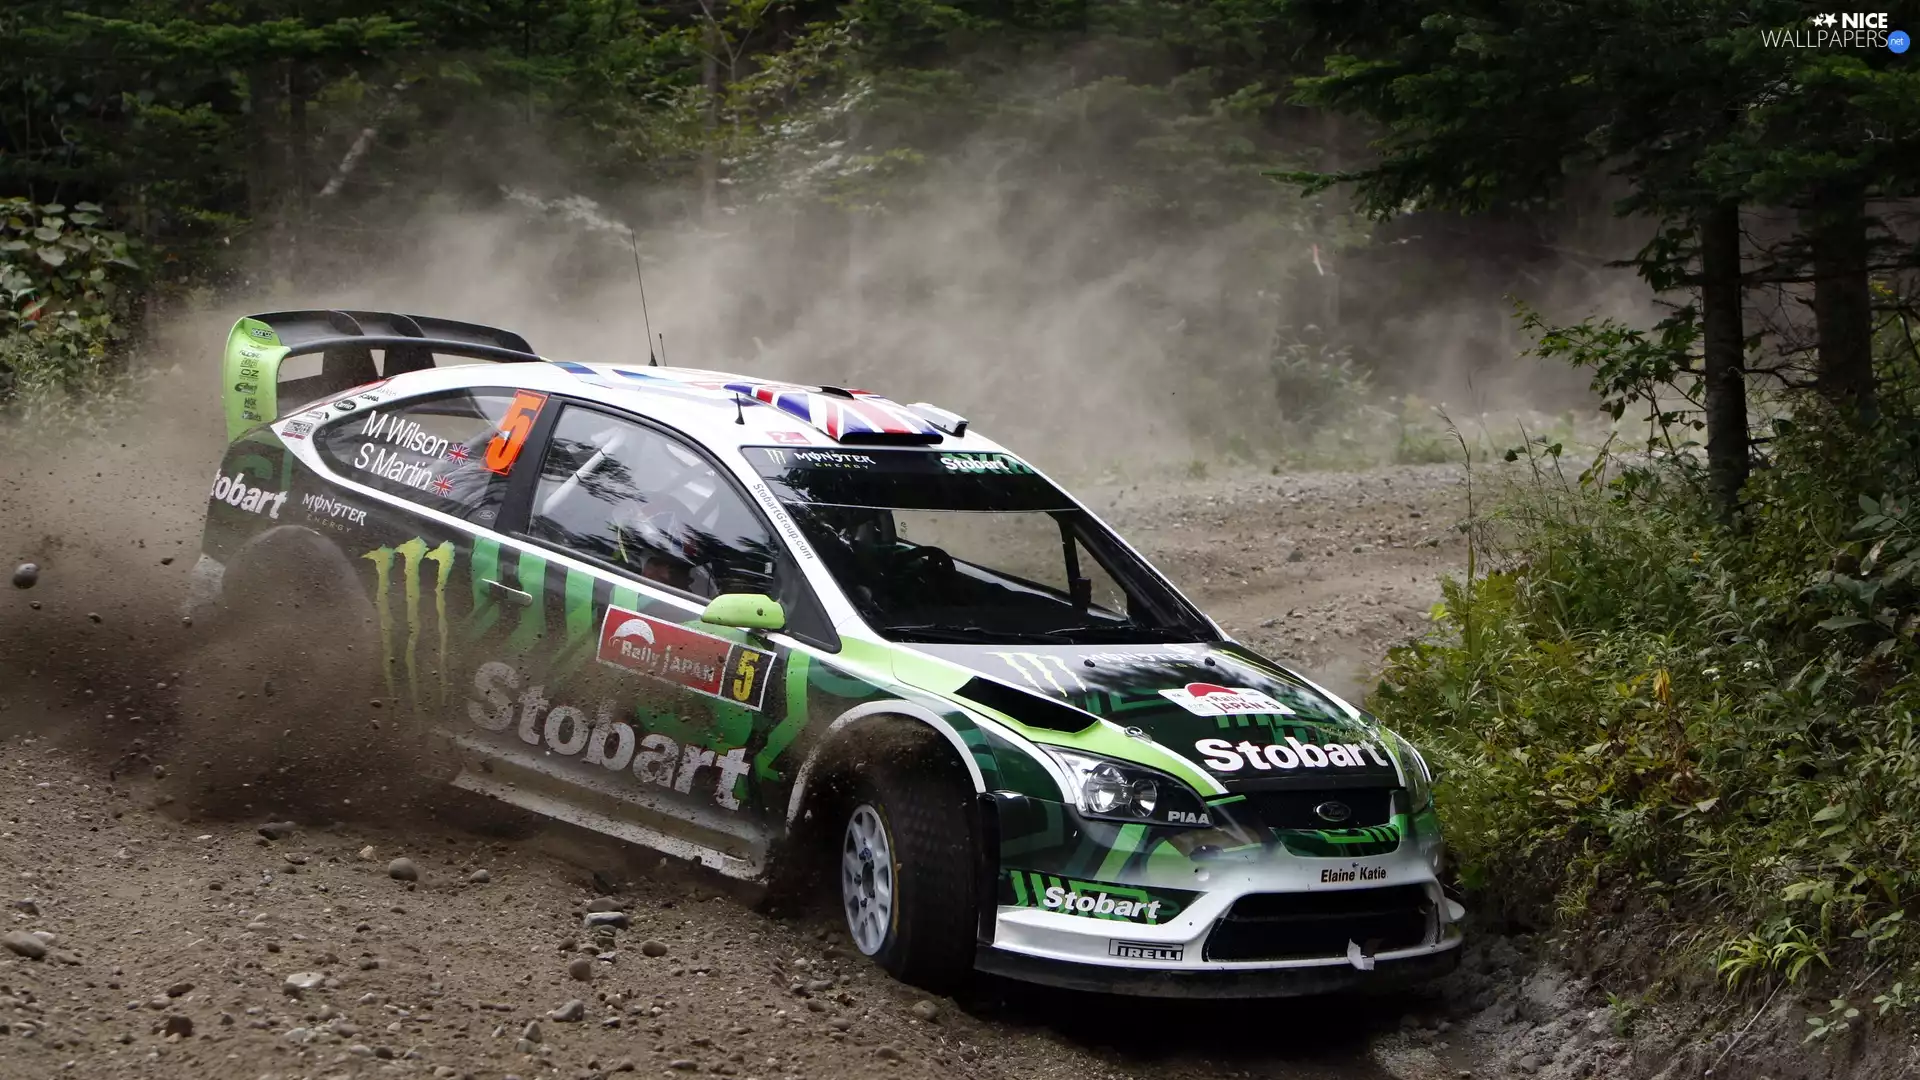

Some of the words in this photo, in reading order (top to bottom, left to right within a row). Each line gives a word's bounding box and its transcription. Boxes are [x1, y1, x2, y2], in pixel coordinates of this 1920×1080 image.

[361, 410, 388, 438] M
[386, 416, 448, 459] Wilson
[485, 392, 544, 470] 5
[354, 443, 374, 470] S
[375, 448, 432, 490] Martin
[815, 462, 869, 470] ENERGY
[941, 457, 1010, 471] Stobart
[307, 515, 351, 532] ENERGY
[753, 484, 814, 560] StobartGroup.com
[621, 640, 661, 667] Rally
[733, 650, 760, 700] 5
[1210, 694, 1246, 703] Rally
[1266, 700, 1281, 710] 5
[466, 661, 751, 812] Stobart
[1195, 737, 1388, 772] Stobart
[1168, 811, 1210, 825] PIAA
[1321, 868, 1355, 883] Elaine
[1359, 867, 1386, 881] Katie
[1043, 886, 1161, 920] Stobart
[1110, 939, 1183, 961] PIRELLI
